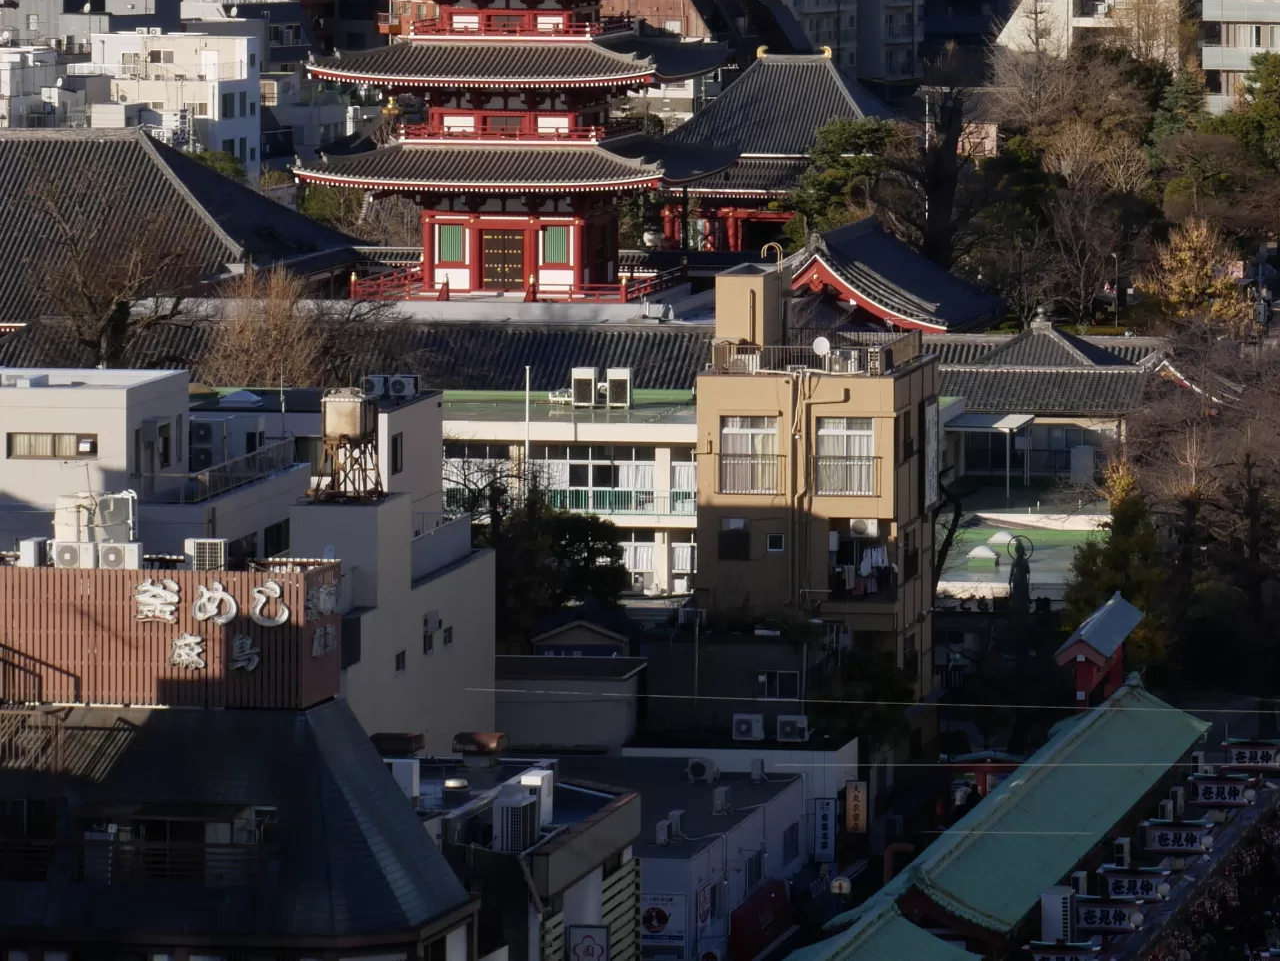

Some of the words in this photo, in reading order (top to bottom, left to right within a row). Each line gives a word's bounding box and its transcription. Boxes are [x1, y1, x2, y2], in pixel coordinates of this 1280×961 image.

[134, 577, 291, 627] 釜めし
[167, 632, 261, 672] 麻鳥
